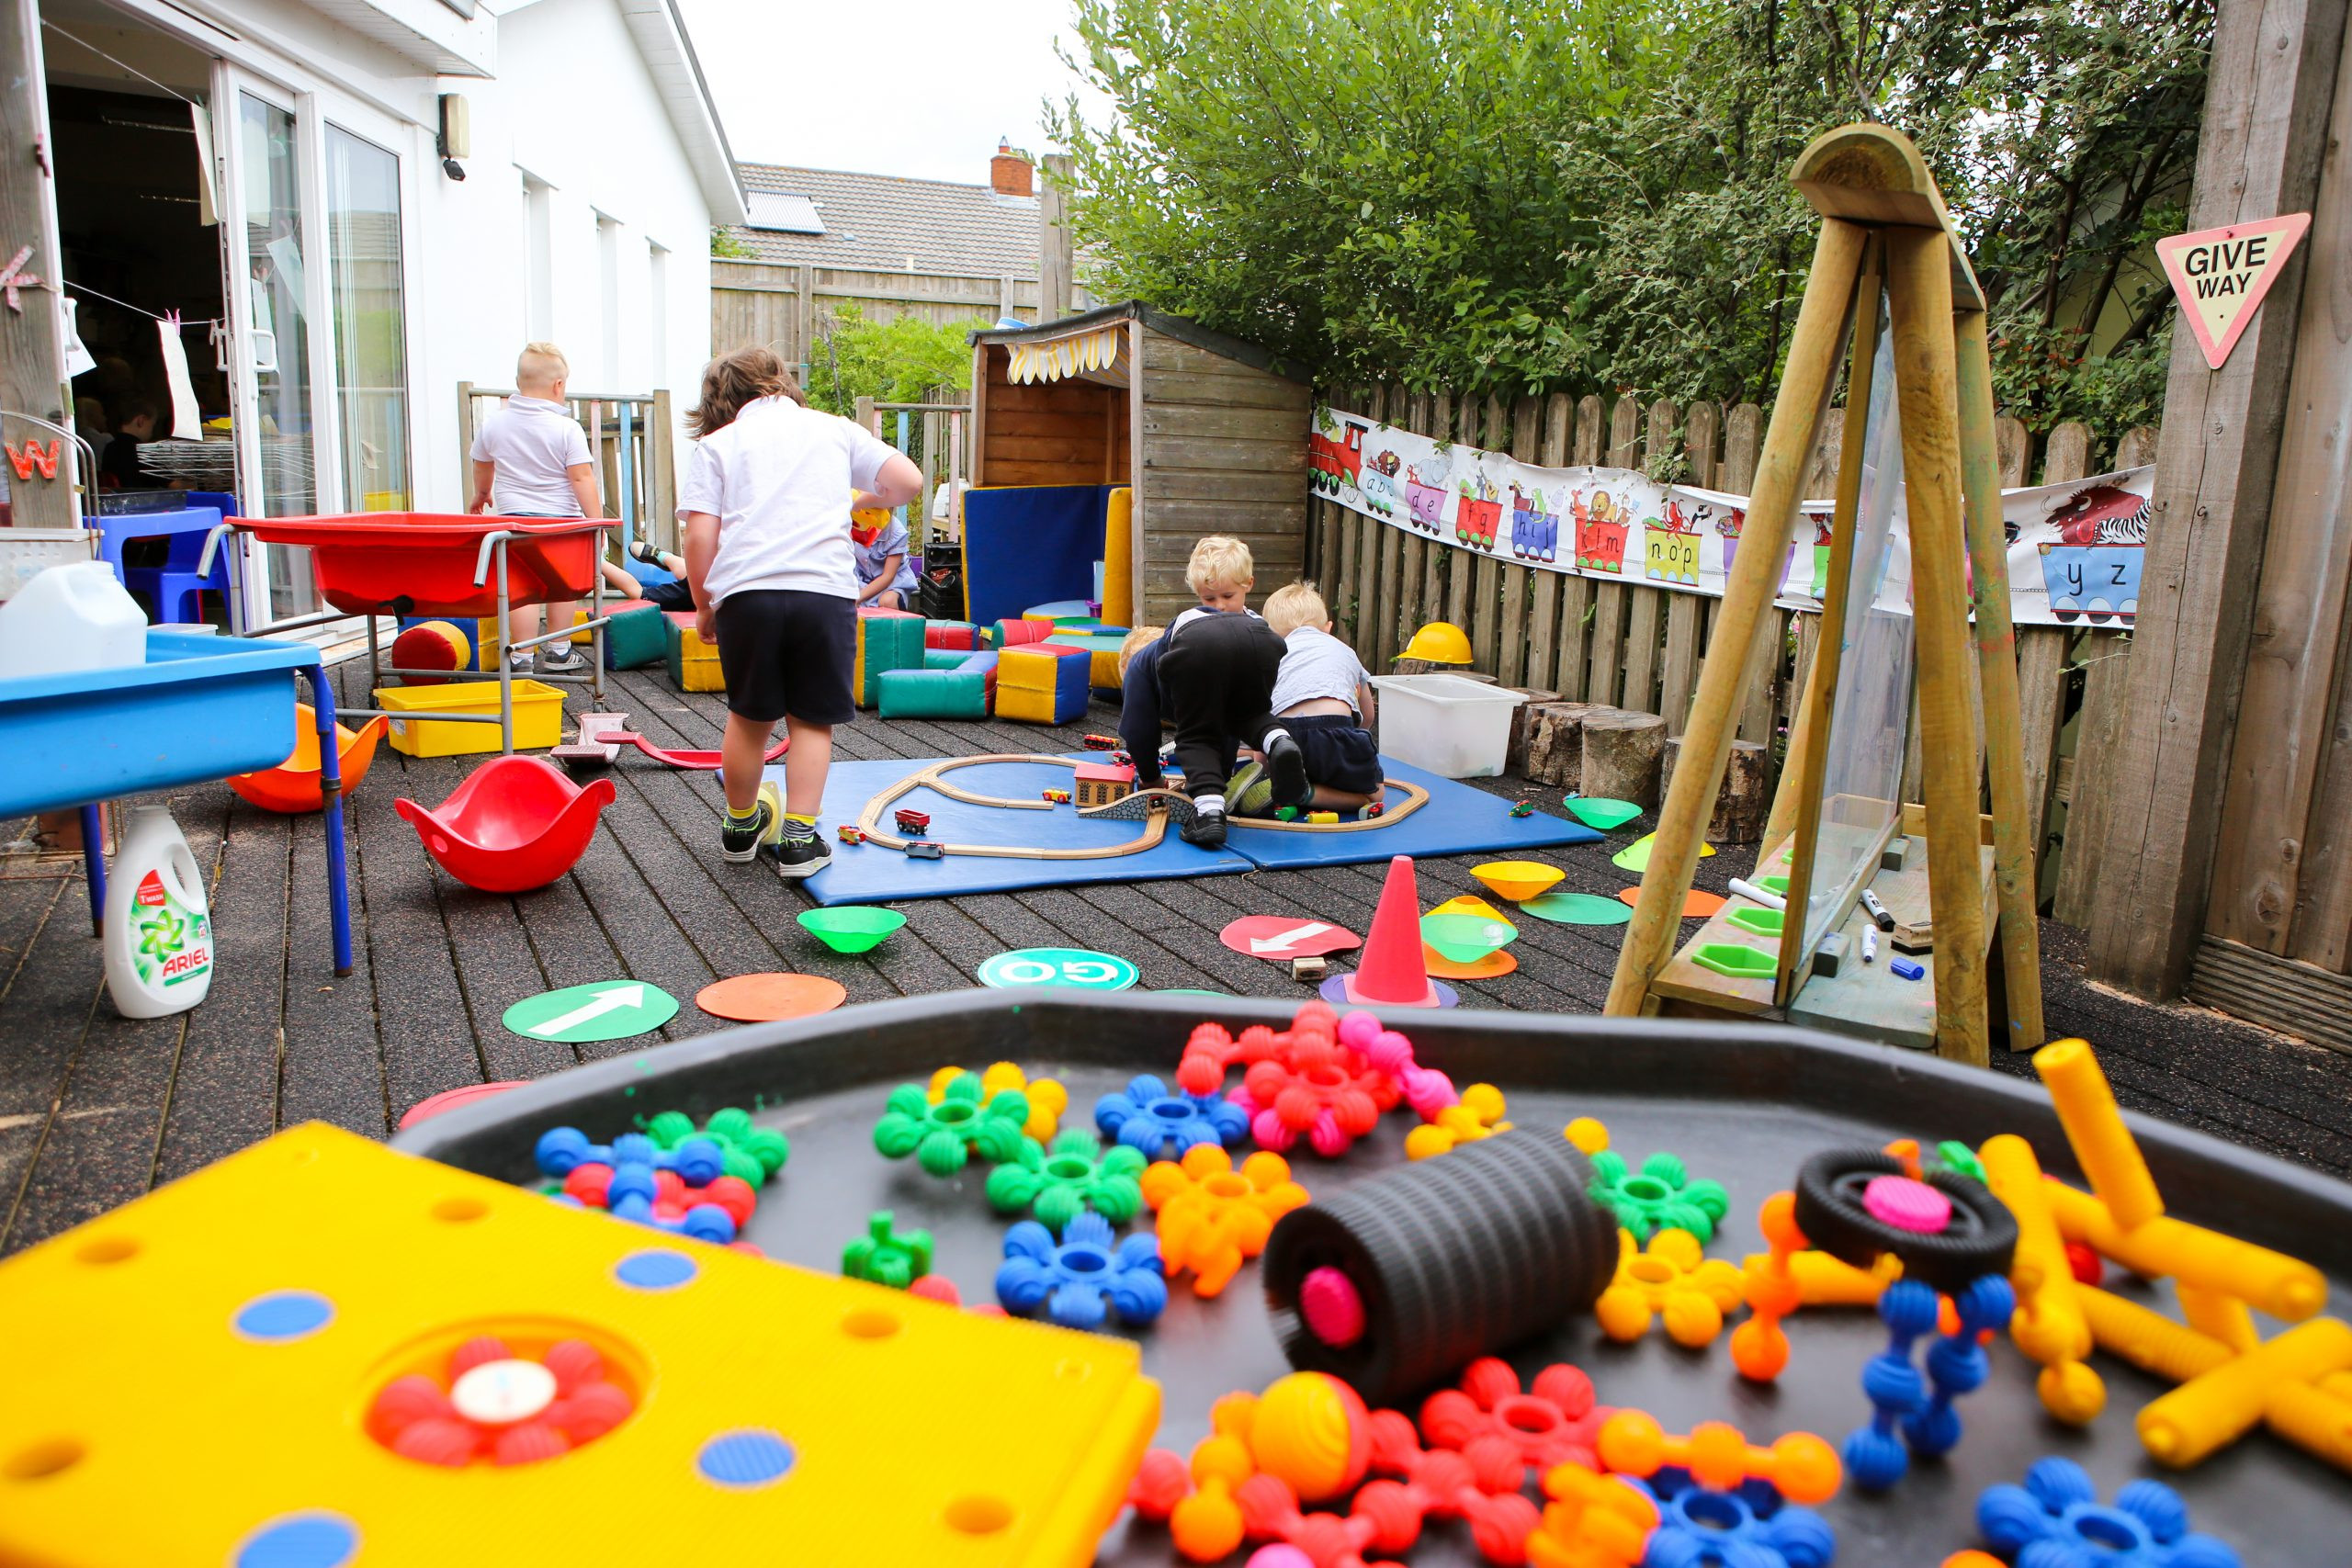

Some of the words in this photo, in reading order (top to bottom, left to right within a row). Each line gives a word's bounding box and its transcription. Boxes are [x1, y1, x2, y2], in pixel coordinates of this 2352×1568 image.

[2185, 237, 2267, 276] GIVE
[2197, 272, 2252, 299] WAY
[5, 439, 62, 480] W
[1412, 491, 1422, 509] d
[1427, 500, 1435, 513] e
[1651, 542, 1661, 558] n
[2067, 562, 2083, 597] y
[2110, 563, 2126, 586] z
[163, 947, 209, 977] ARIEL
[999, 961, 1119, 983] GO
